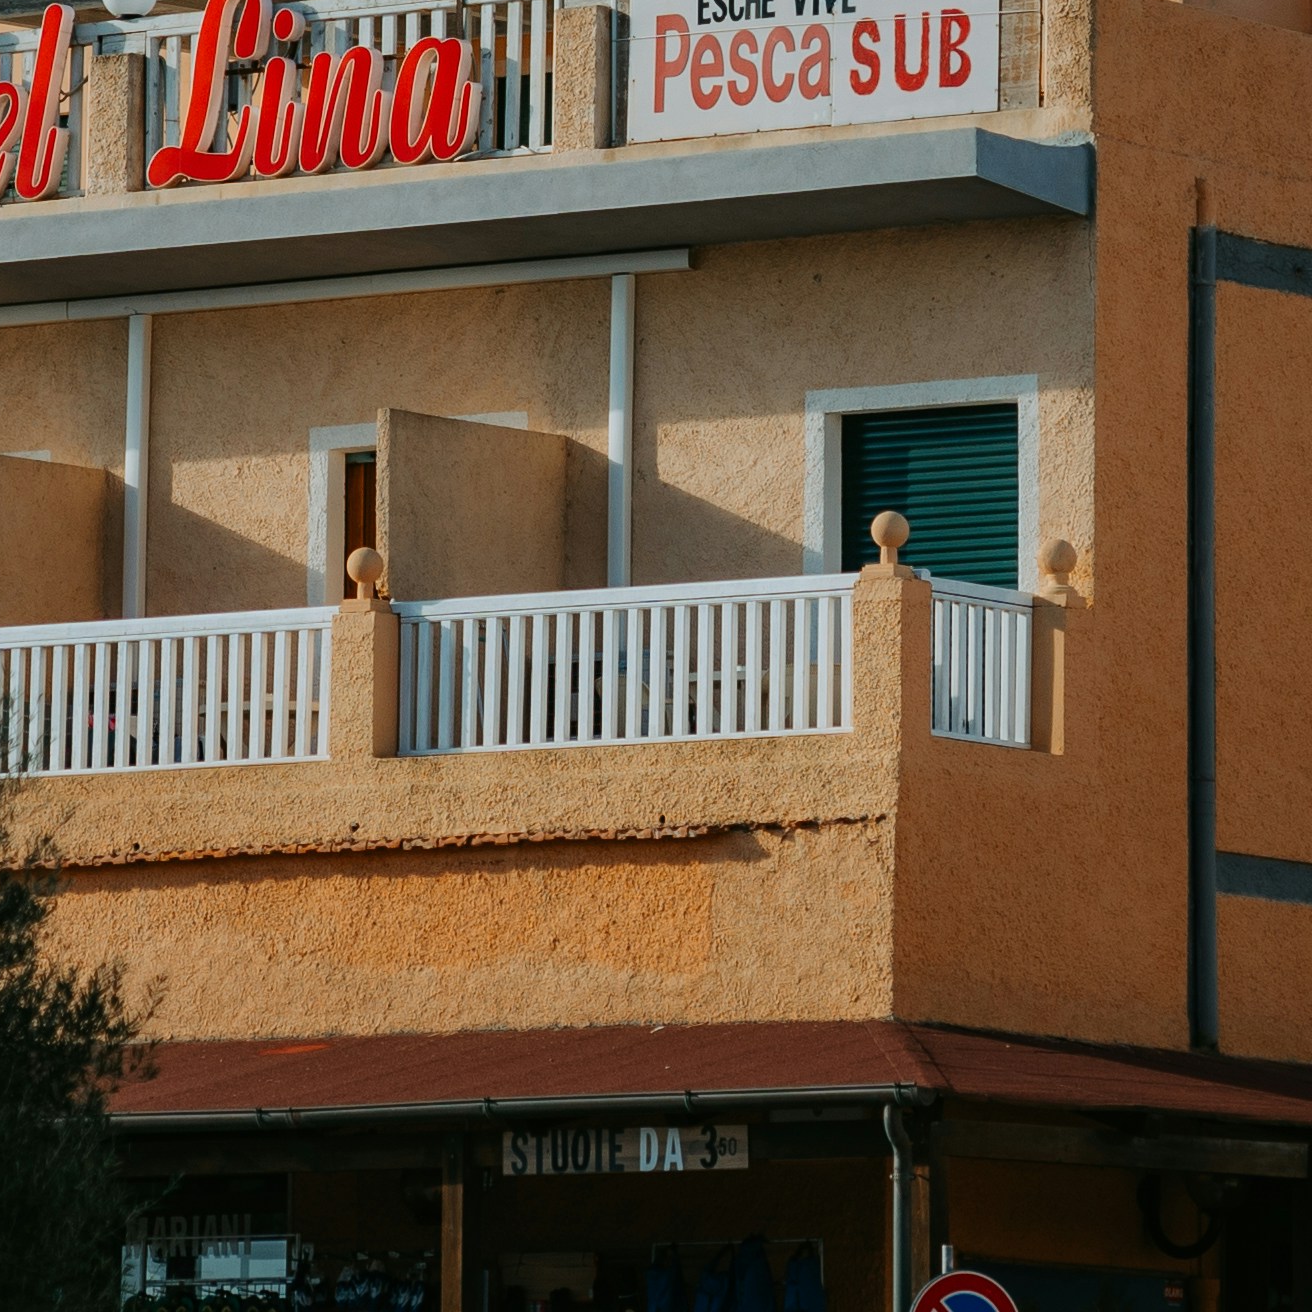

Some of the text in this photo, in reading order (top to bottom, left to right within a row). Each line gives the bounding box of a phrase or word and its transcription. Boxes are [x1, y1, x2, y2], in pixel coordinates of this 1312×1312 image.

[653, 8, 972, 113] Pesca SUB
[511, 1127, 625, 1175] STUOIE
[639, 1127, 684, 1171] DA
